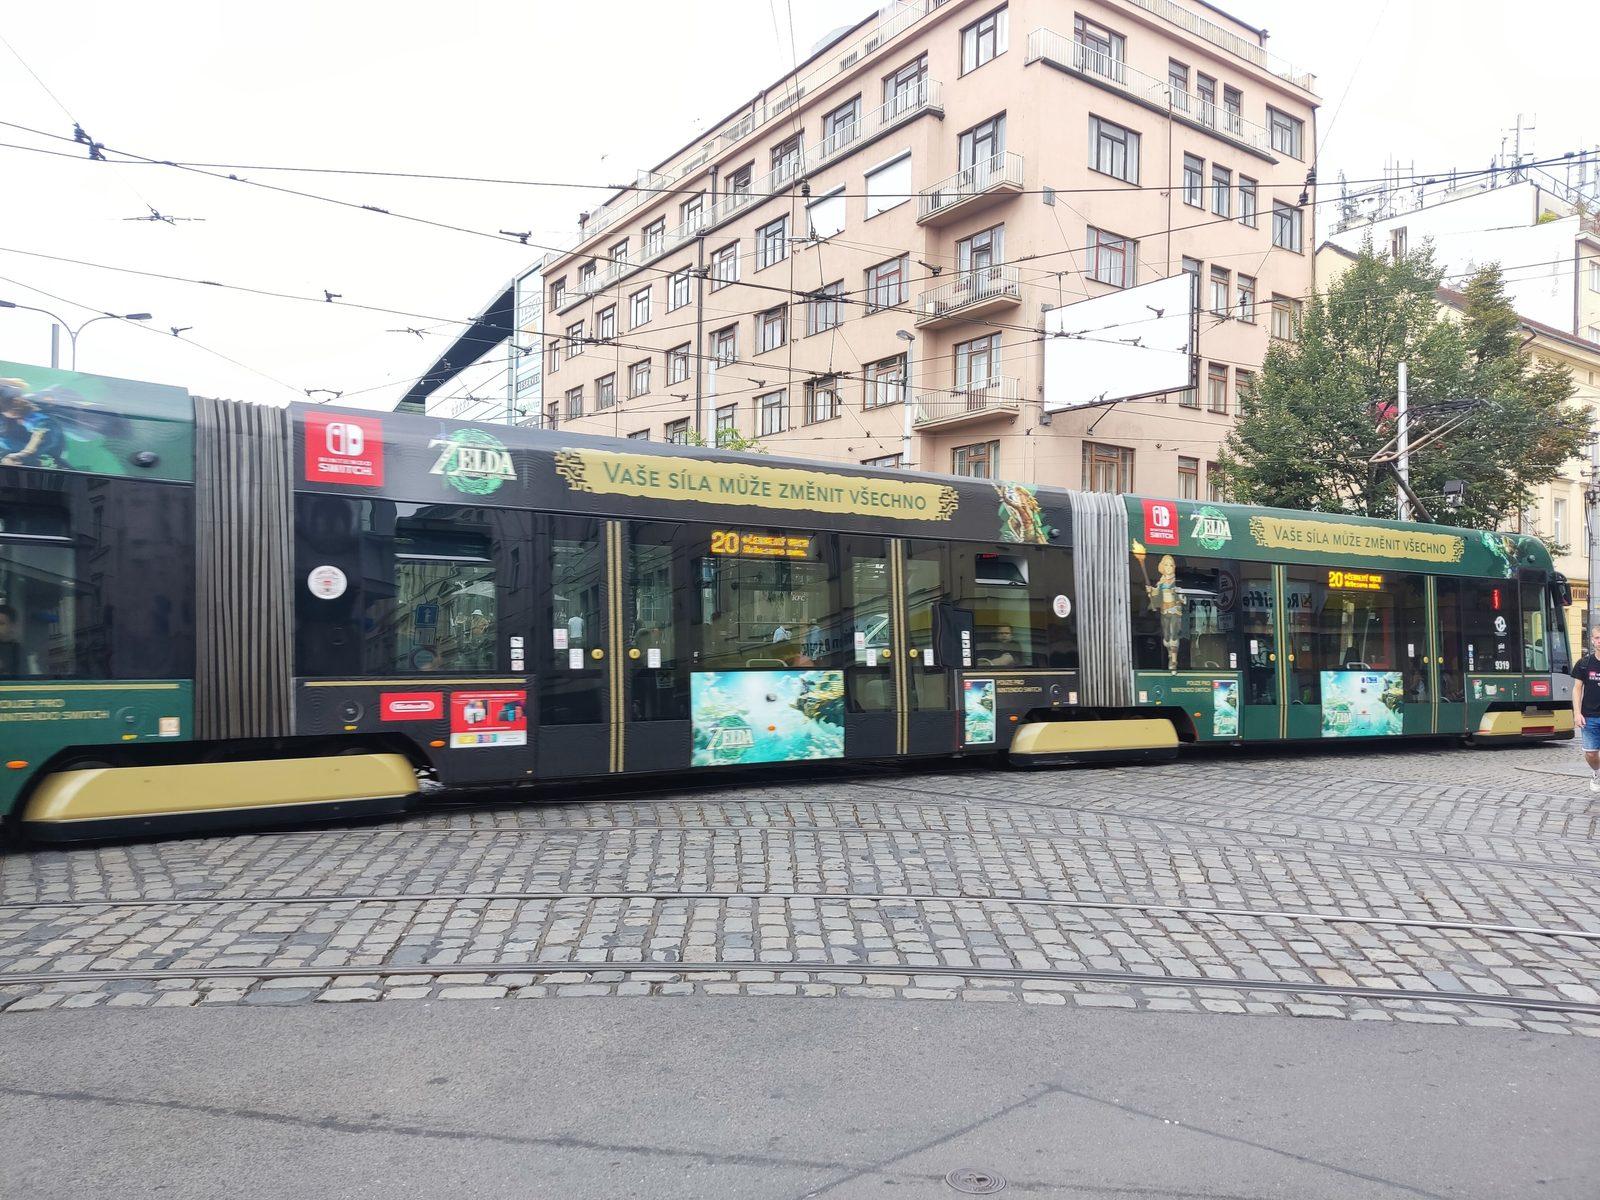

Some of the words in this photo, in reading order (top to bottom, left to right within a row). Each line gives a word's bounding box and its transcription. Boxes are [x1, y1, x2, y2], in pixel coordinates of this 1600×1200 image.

[517, 374, 540, 392] RESERVED
[427, 438, 518, 481] ZELDA
[603, 461, 661, 488] VAŠE
[668, 468, 712, 492] SÍLA
[719, 472, 772, 498] MŮŽE
[778, 480, 845, 503] ZMĚNIT
[850, 486, 927, 511] VŠECHNO
[1190, 514, 1233, 541] ZELDA
[1273, 524, 1302, 543] VAŠE
[1306, 528, 1329, 545] SÍLA
[1332, 530, 1361, 548] MŮŽE
[1364, 535, 1400, 551] ZMĚNIT
[1403, 537, 1447, 555] VŠECHNO
[711, 530, 740, 554] 20
[1328, 571, 1344, 588] 20
[1494, 660, 1510, 670] 9319
